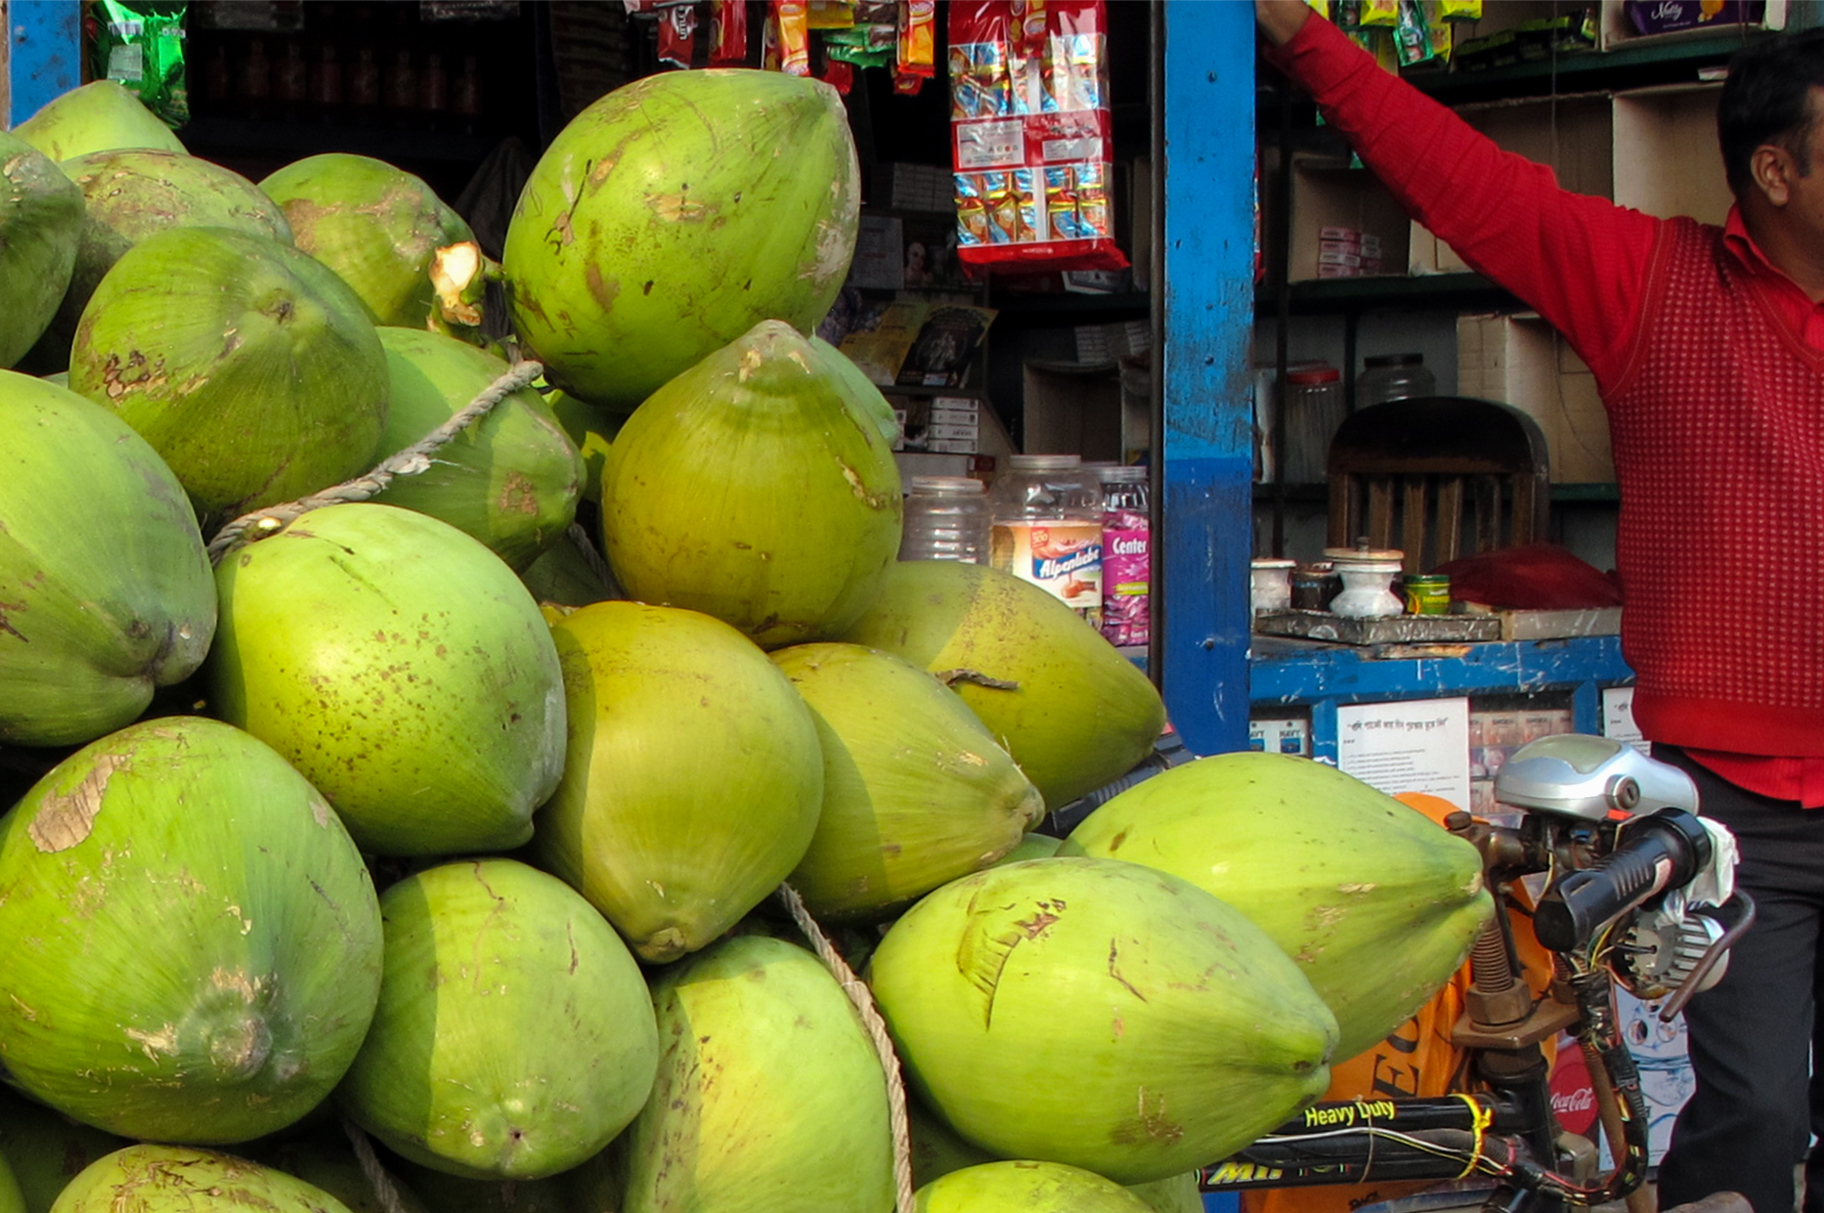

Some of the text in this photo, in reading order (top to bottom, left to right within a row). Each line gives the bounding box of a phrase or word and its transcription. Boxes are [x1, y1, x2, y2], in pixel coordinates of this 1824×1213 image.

[1112, 536, 1147, 555] Center
[1039, 548, 1101, 580] Alpenliebe
[1305, 1100, 1396, 1128] Heavy Duty
